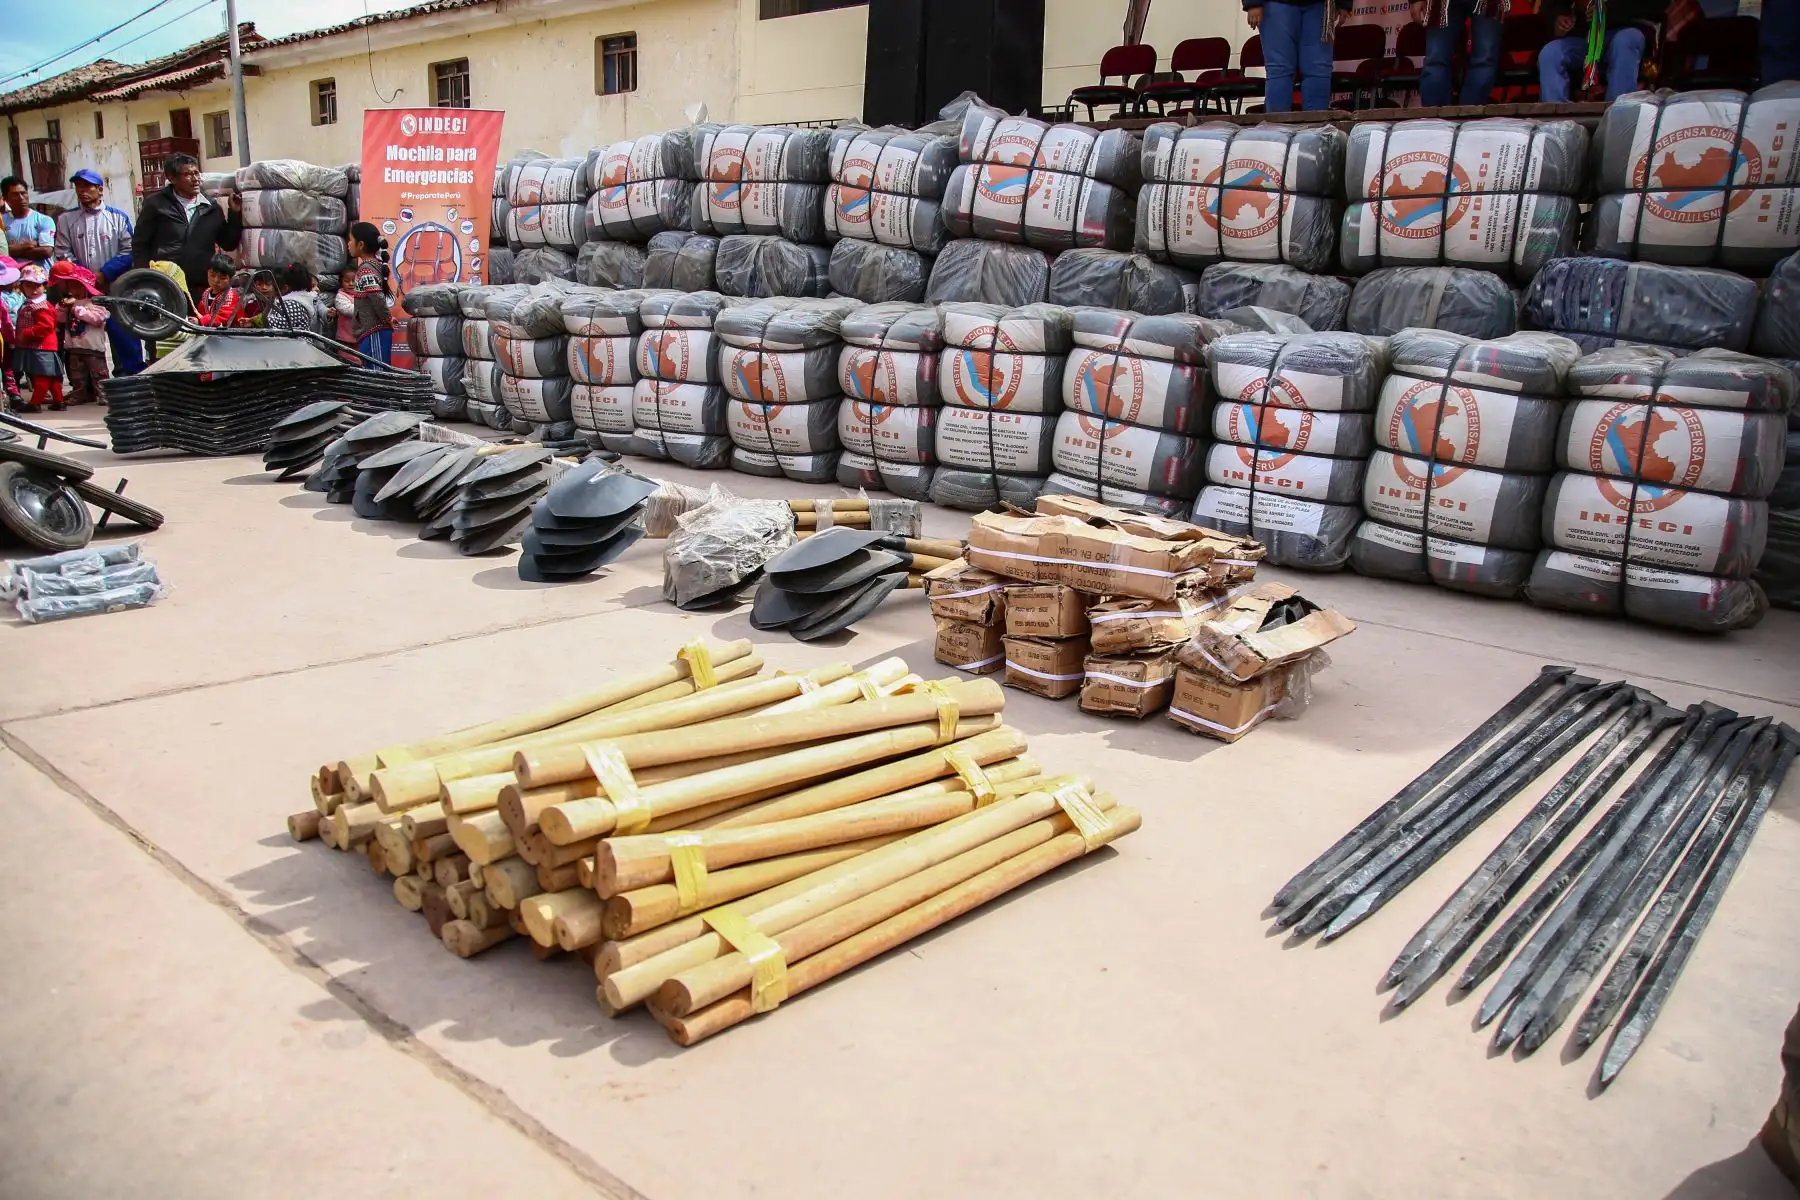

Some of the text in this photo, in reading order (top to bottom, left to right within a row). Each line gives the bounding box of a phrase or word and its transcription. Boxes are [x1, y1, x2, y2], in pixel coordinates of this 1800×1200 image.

[419, 117, 467, 132] INDECI
[1654, 127, 1707, 150] DEFENSA
[386, 144, 477, 163] Mochila para
[1385, 152, 1427, 172] DEFENSA
[383, 167, 474, 186] Emergencias
[1749, 157, 1761, 185] ERÚ
[1470, 152, 1490, 241] INDECI
[1663, 208, 1721, 222] INSTITUTO
[1008, 373, 1020, 393] CIVIL
[1131, 359, 1143, 400] DEFENSA
[1463, 396, 1480, 445] DEFENSA
[1682, 409, 1704, 462] DEFENSA
[1064, 436, 1133, 458] INDECI
[1223, 469, 1304, 490] INDECI
[1379, 486, 1468, 512] INDECI
[1615, 498, 1655, 512] PRÚ
[1216, 509, 1236, 517] CANTIDAD
[1579, 511, 1692, 535] INDECI
[1573, 564, 1600, 575] CANTIDAD
[1649, 577, 1680, 585] UNIDADES
